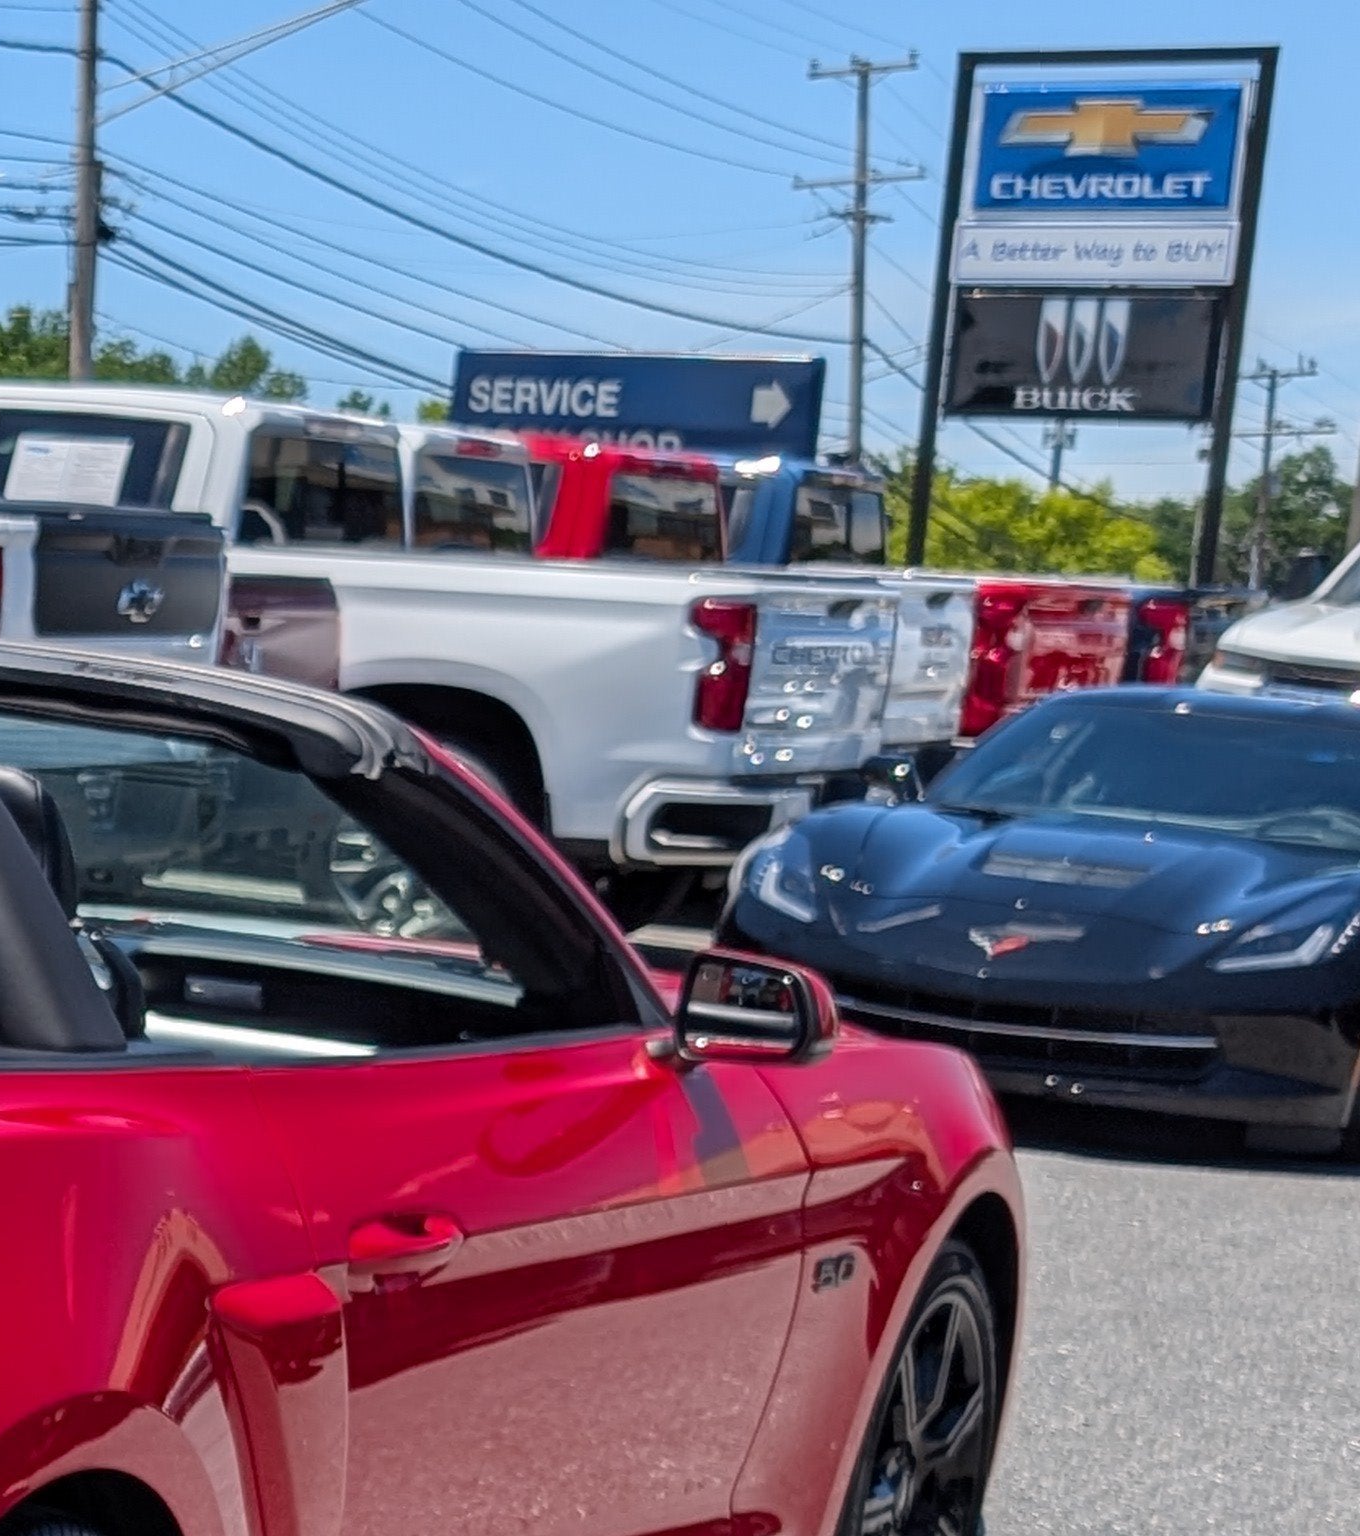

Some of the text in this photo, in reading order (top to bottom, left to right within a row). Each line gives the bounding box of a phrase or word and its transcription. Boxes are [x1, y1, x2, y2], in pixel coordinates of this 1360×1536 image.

[990, 172, 1212, 199] CHEVROLET
[961, 238, 979, 260] A
[991, 238, 1065, 262] Better
[1074, 238, 1123, 267] Way
[1132, 239, 1157, 262] to
[468, 375, 622, 417] SERVICE
[1014, 386, 1138, 412] BUICK
